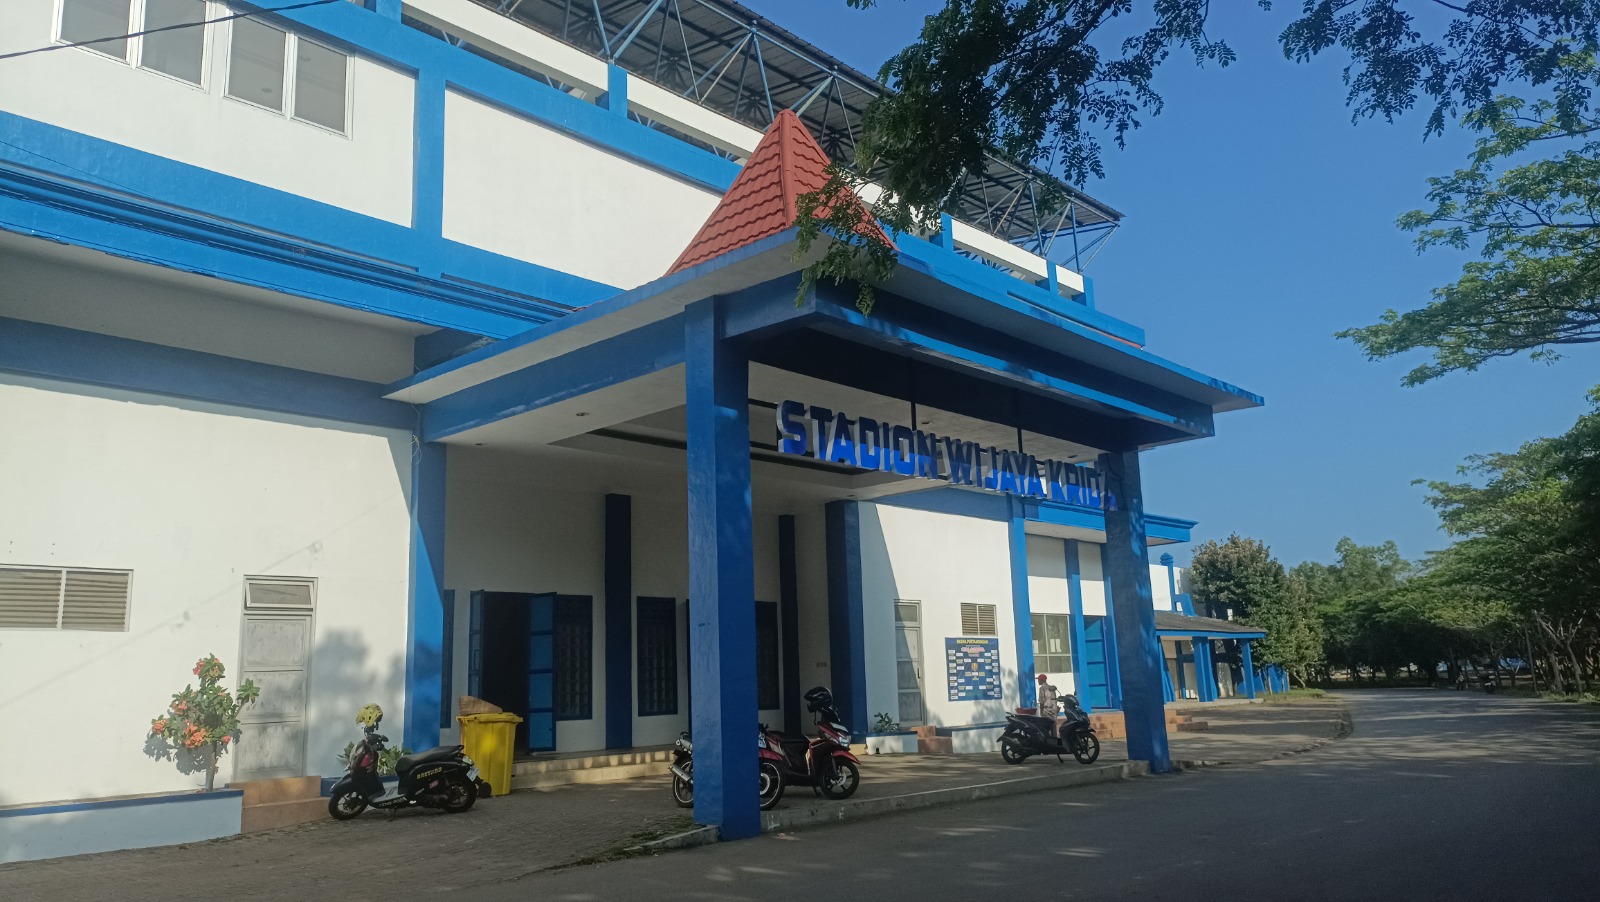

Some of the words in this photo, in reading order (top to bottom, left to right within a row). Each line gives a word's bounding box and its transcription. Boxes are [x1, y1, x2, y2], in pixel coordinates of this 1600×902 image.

[777, 400, 938, 479] STADION
[942, 436, 1045, 497] WIJAYA
[1045, 459, 1118, 511] KRIDA
